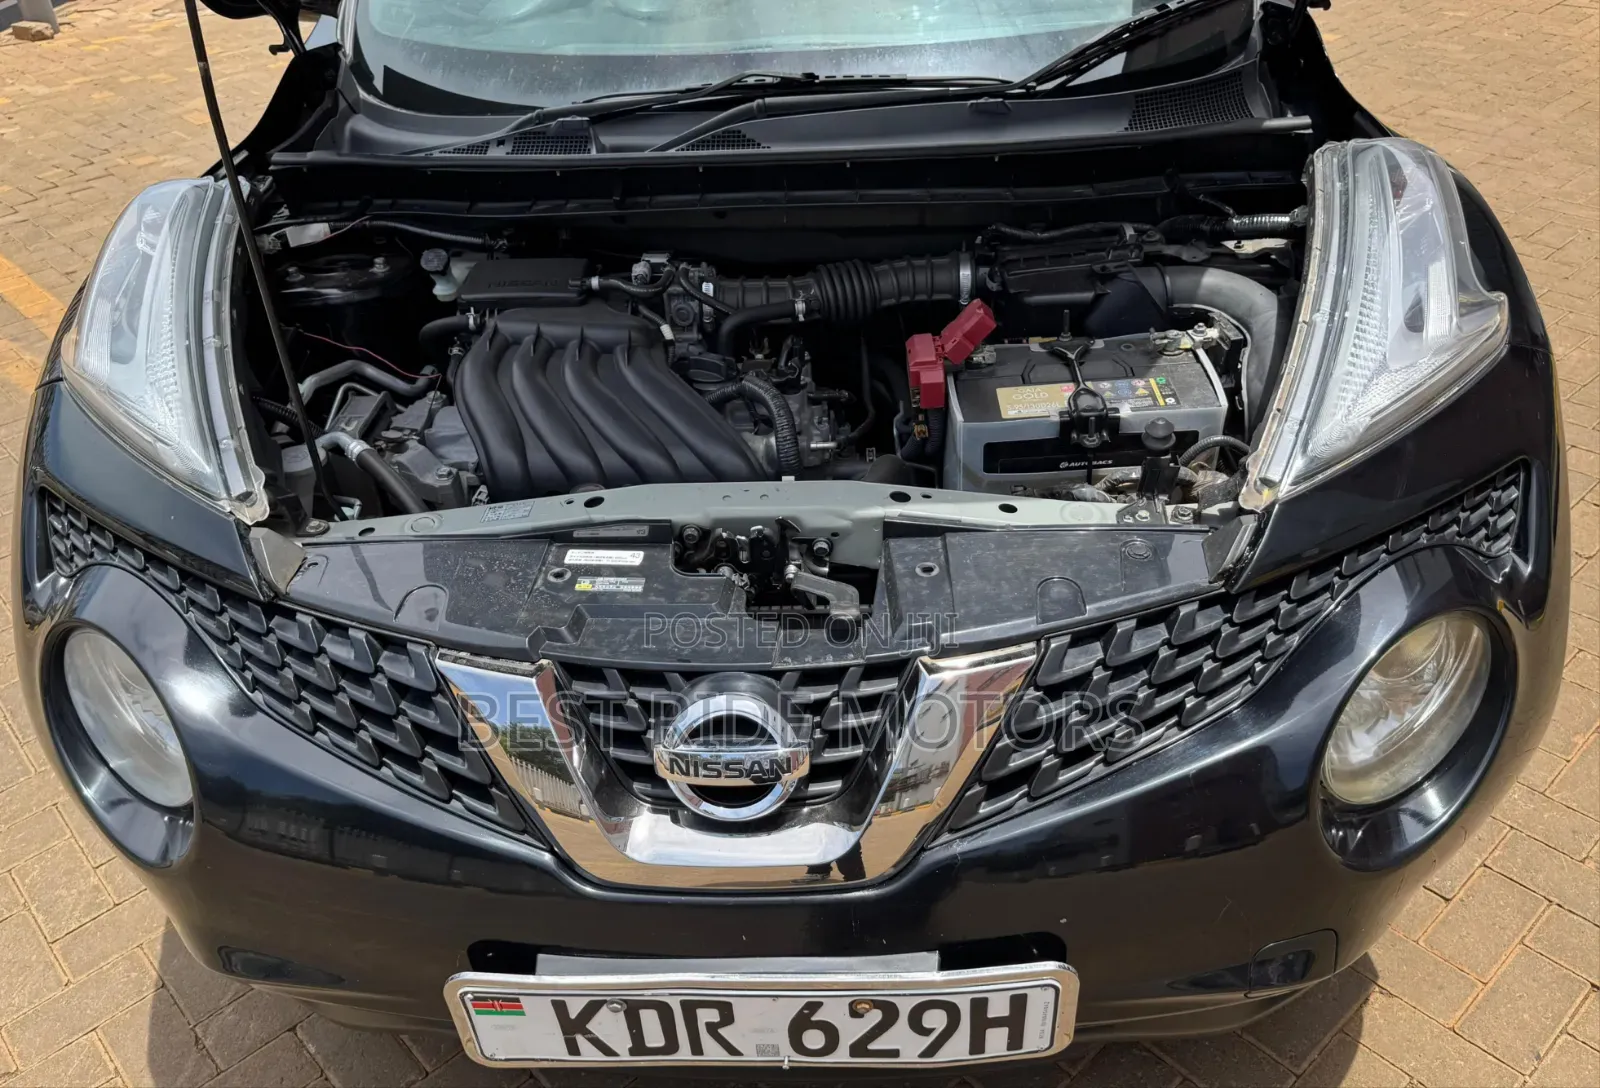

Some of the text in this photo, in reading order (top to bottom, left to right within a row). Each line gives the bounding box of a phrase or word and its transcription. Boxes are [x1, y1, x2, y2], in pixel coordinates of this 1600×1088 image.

[1012, 392, 1049, 400] GOLD
[669, 757, 793, 781] NISSAN
[550, 999, 744, 1057] KDR
[787, 993, 1028, 1058] 629H
